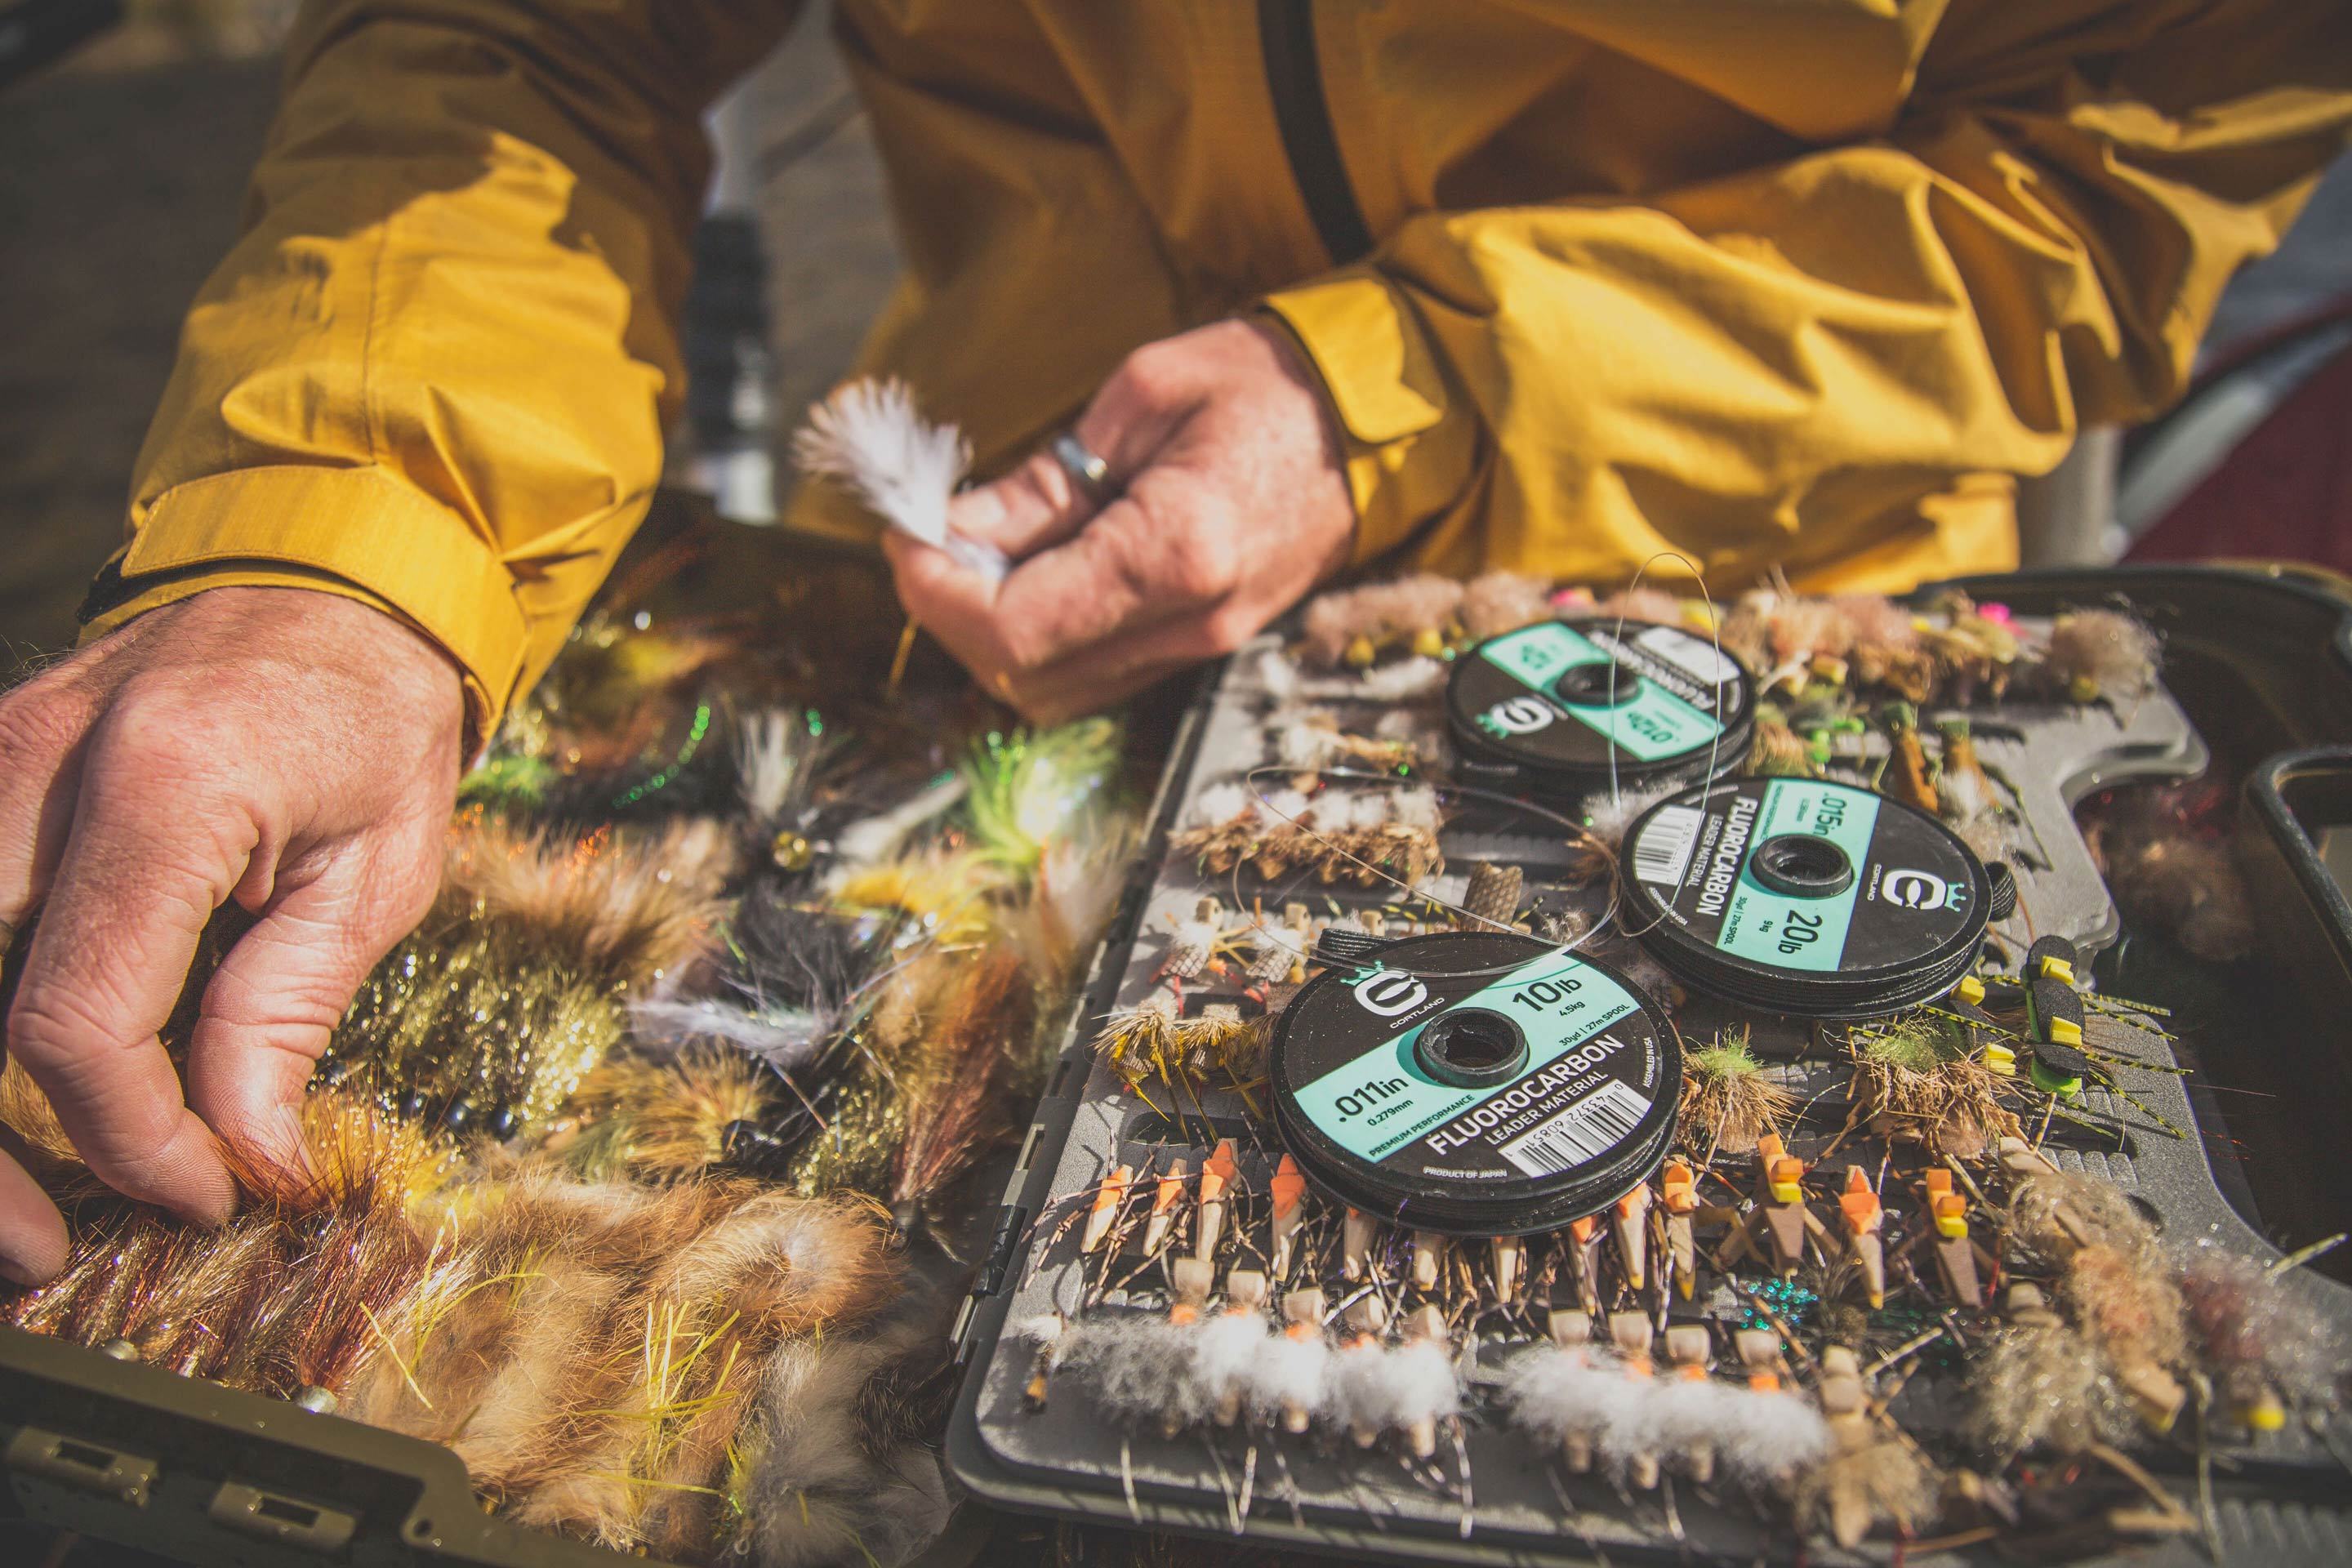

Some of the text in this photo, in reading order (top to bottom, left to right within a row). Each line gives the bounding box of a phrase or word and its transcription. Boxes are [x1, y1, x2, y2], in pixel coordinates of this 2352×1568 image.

[1704, 813, 1724, 847] LEADER
[1686, 844, 1712, 888] MATERIAL
[1696, 795, 1758, 916] FLUOROCARBON
[1724, 926, 1737, 945] SPOOL
[1390, 997, 1445, 1029] CORTLAND
[1559, 1000, 1585, 1017] 4.5kg
[1559, 1031, 1581, 1046] 30yd
[1585, 1018, 1605, 1031] 27m
[1602, 1004, 1630, 1021] SPOOL
[1643, 1037, 1655, 1048] USA
[1335, 1078, 1409, 1123] .011in
[1367, 1099, 1414, 1126] 0.279mm
[1425, 1034, 1625, 1156] FLUOROCARBON
[1484, 1071, 1609, 1146] LEADER MATERIAL
[1369, 1094, 1475, 1156] PREMIUM PERFORMANCE
[1423, 1165, 1508, 1178] PRODUCT OF JAPAN
